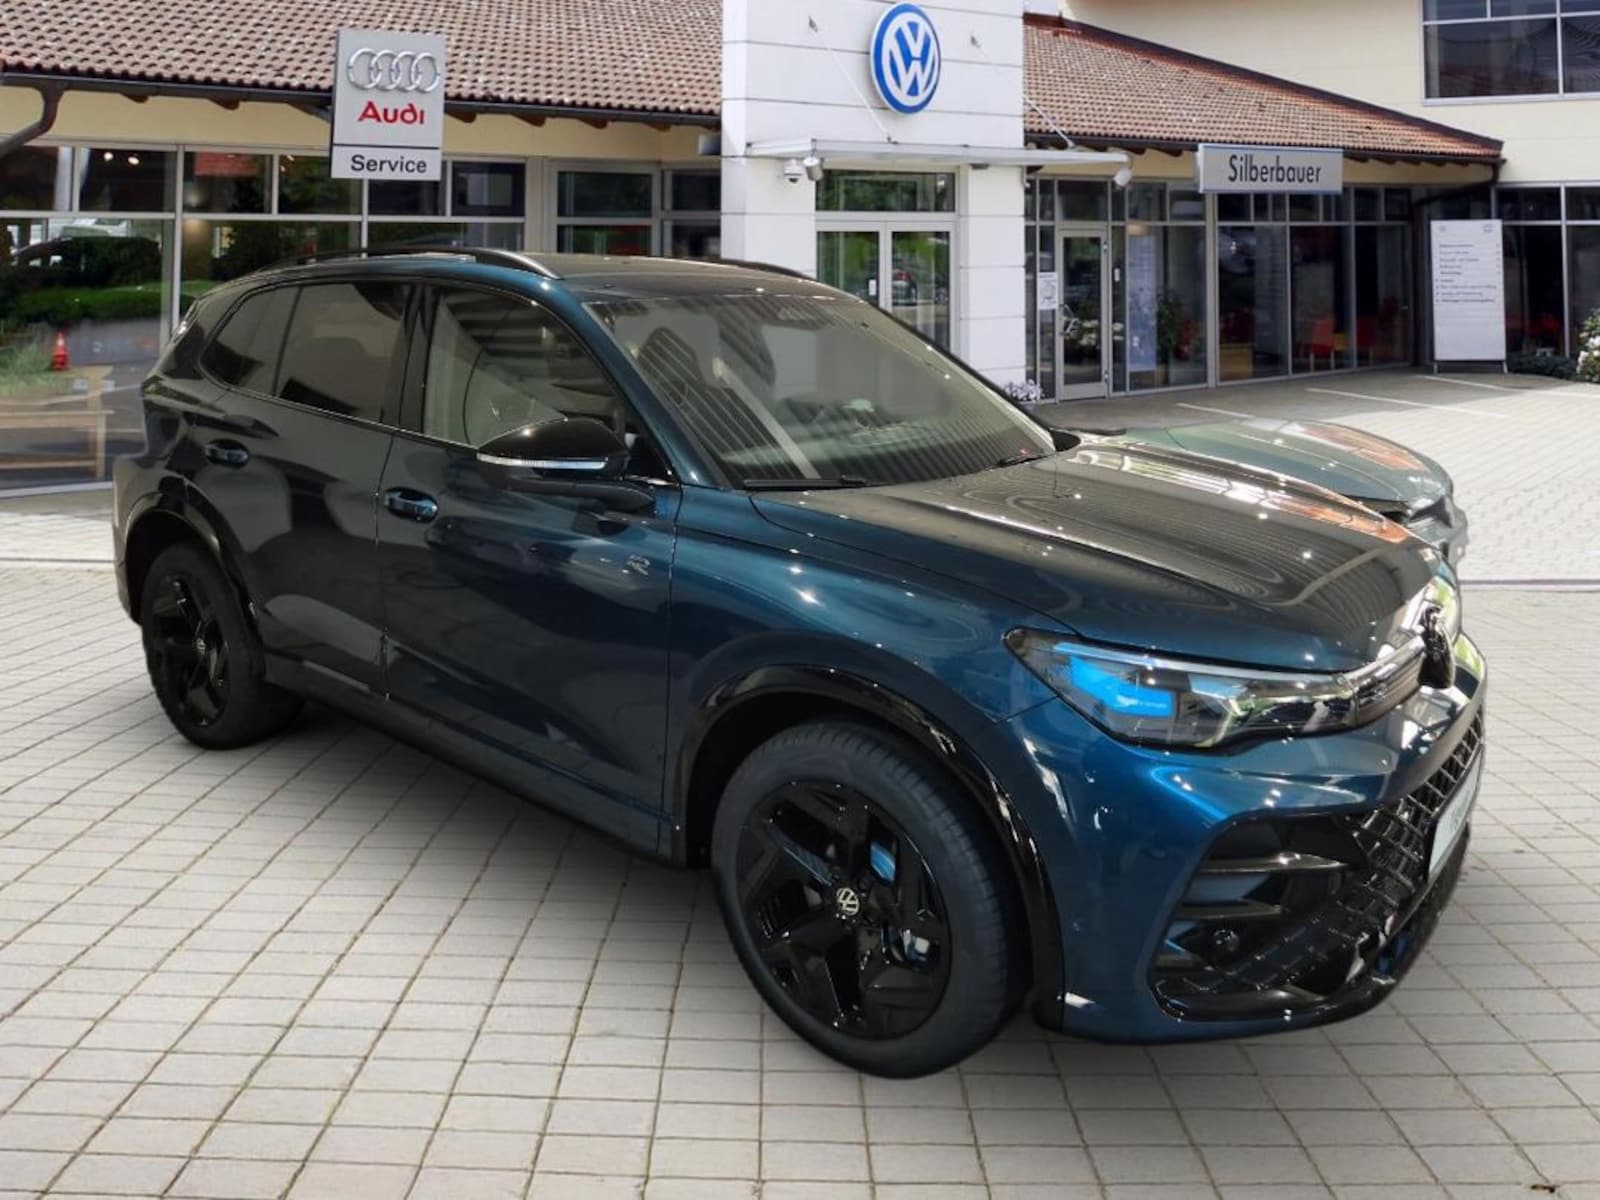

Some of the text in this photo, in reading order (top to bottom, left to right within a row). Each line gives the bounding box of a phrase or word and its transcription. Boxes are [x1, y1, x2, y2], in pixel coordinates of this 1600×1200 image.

[357, 101, 425, 125] Audi
[351, 154, 427, 173] Service
[1228, 154, 1321, 183] Silberbauer
